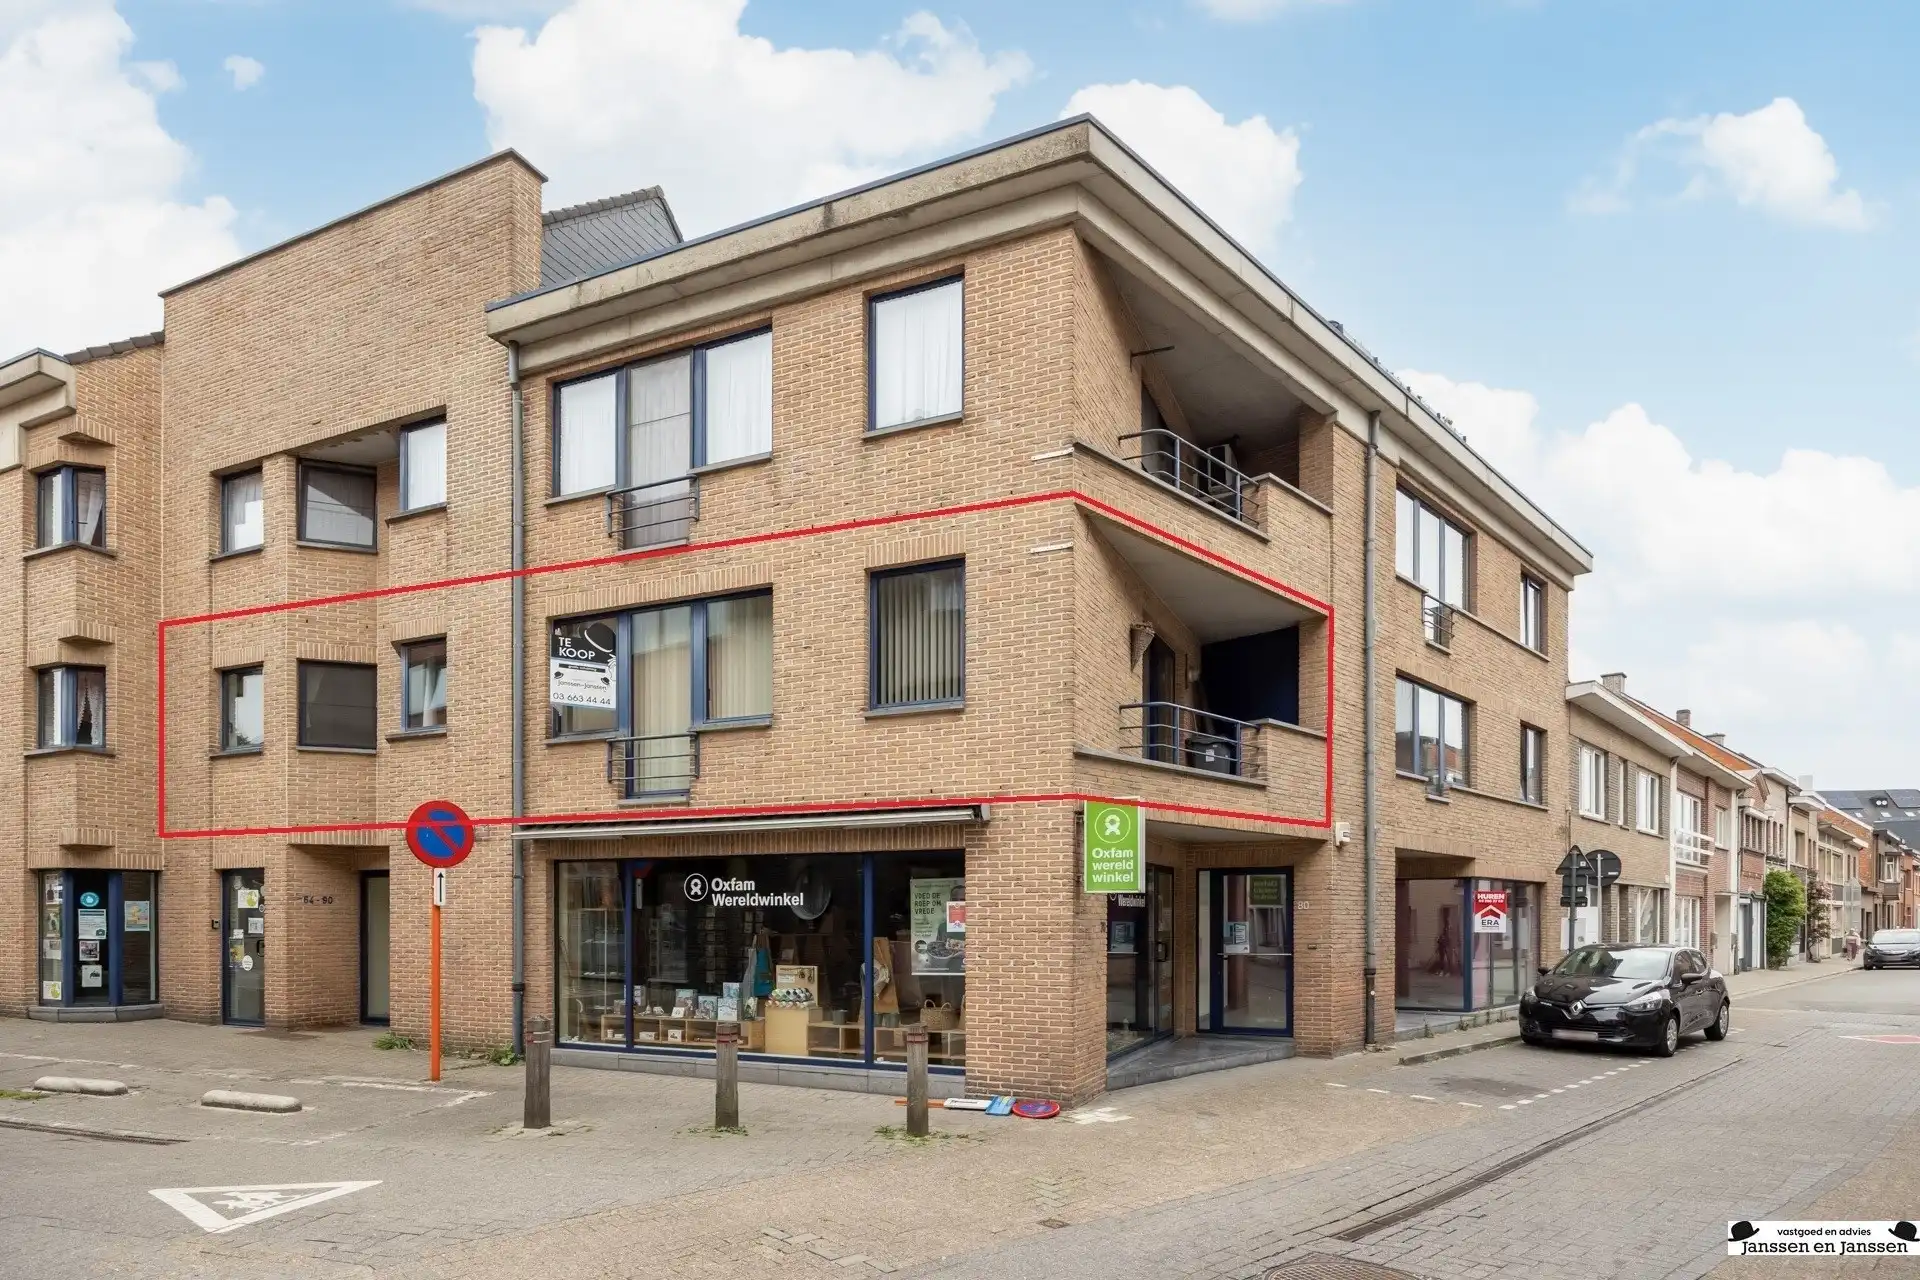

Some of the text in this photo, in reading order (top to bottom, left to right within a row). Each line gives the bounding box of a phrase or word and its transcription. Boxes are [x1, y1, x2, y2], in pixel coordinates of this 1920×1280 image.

[559, 637, 572, 647] TE
[559, 647, 596, 660] KOOP
[553, 692, 565, 700] 03
[567, 694, 584, 702] 663
[1092, 848, 1134, 858] Oxfam
[1092, 860, 1134, 870] wereld
[1092, 872, 1134, 883] winkel
[711, 877, 756, 892] Oxfam
[711, 892, 804, 907] Wereldwinkel
[1297, 901, 1310, 910] 80
